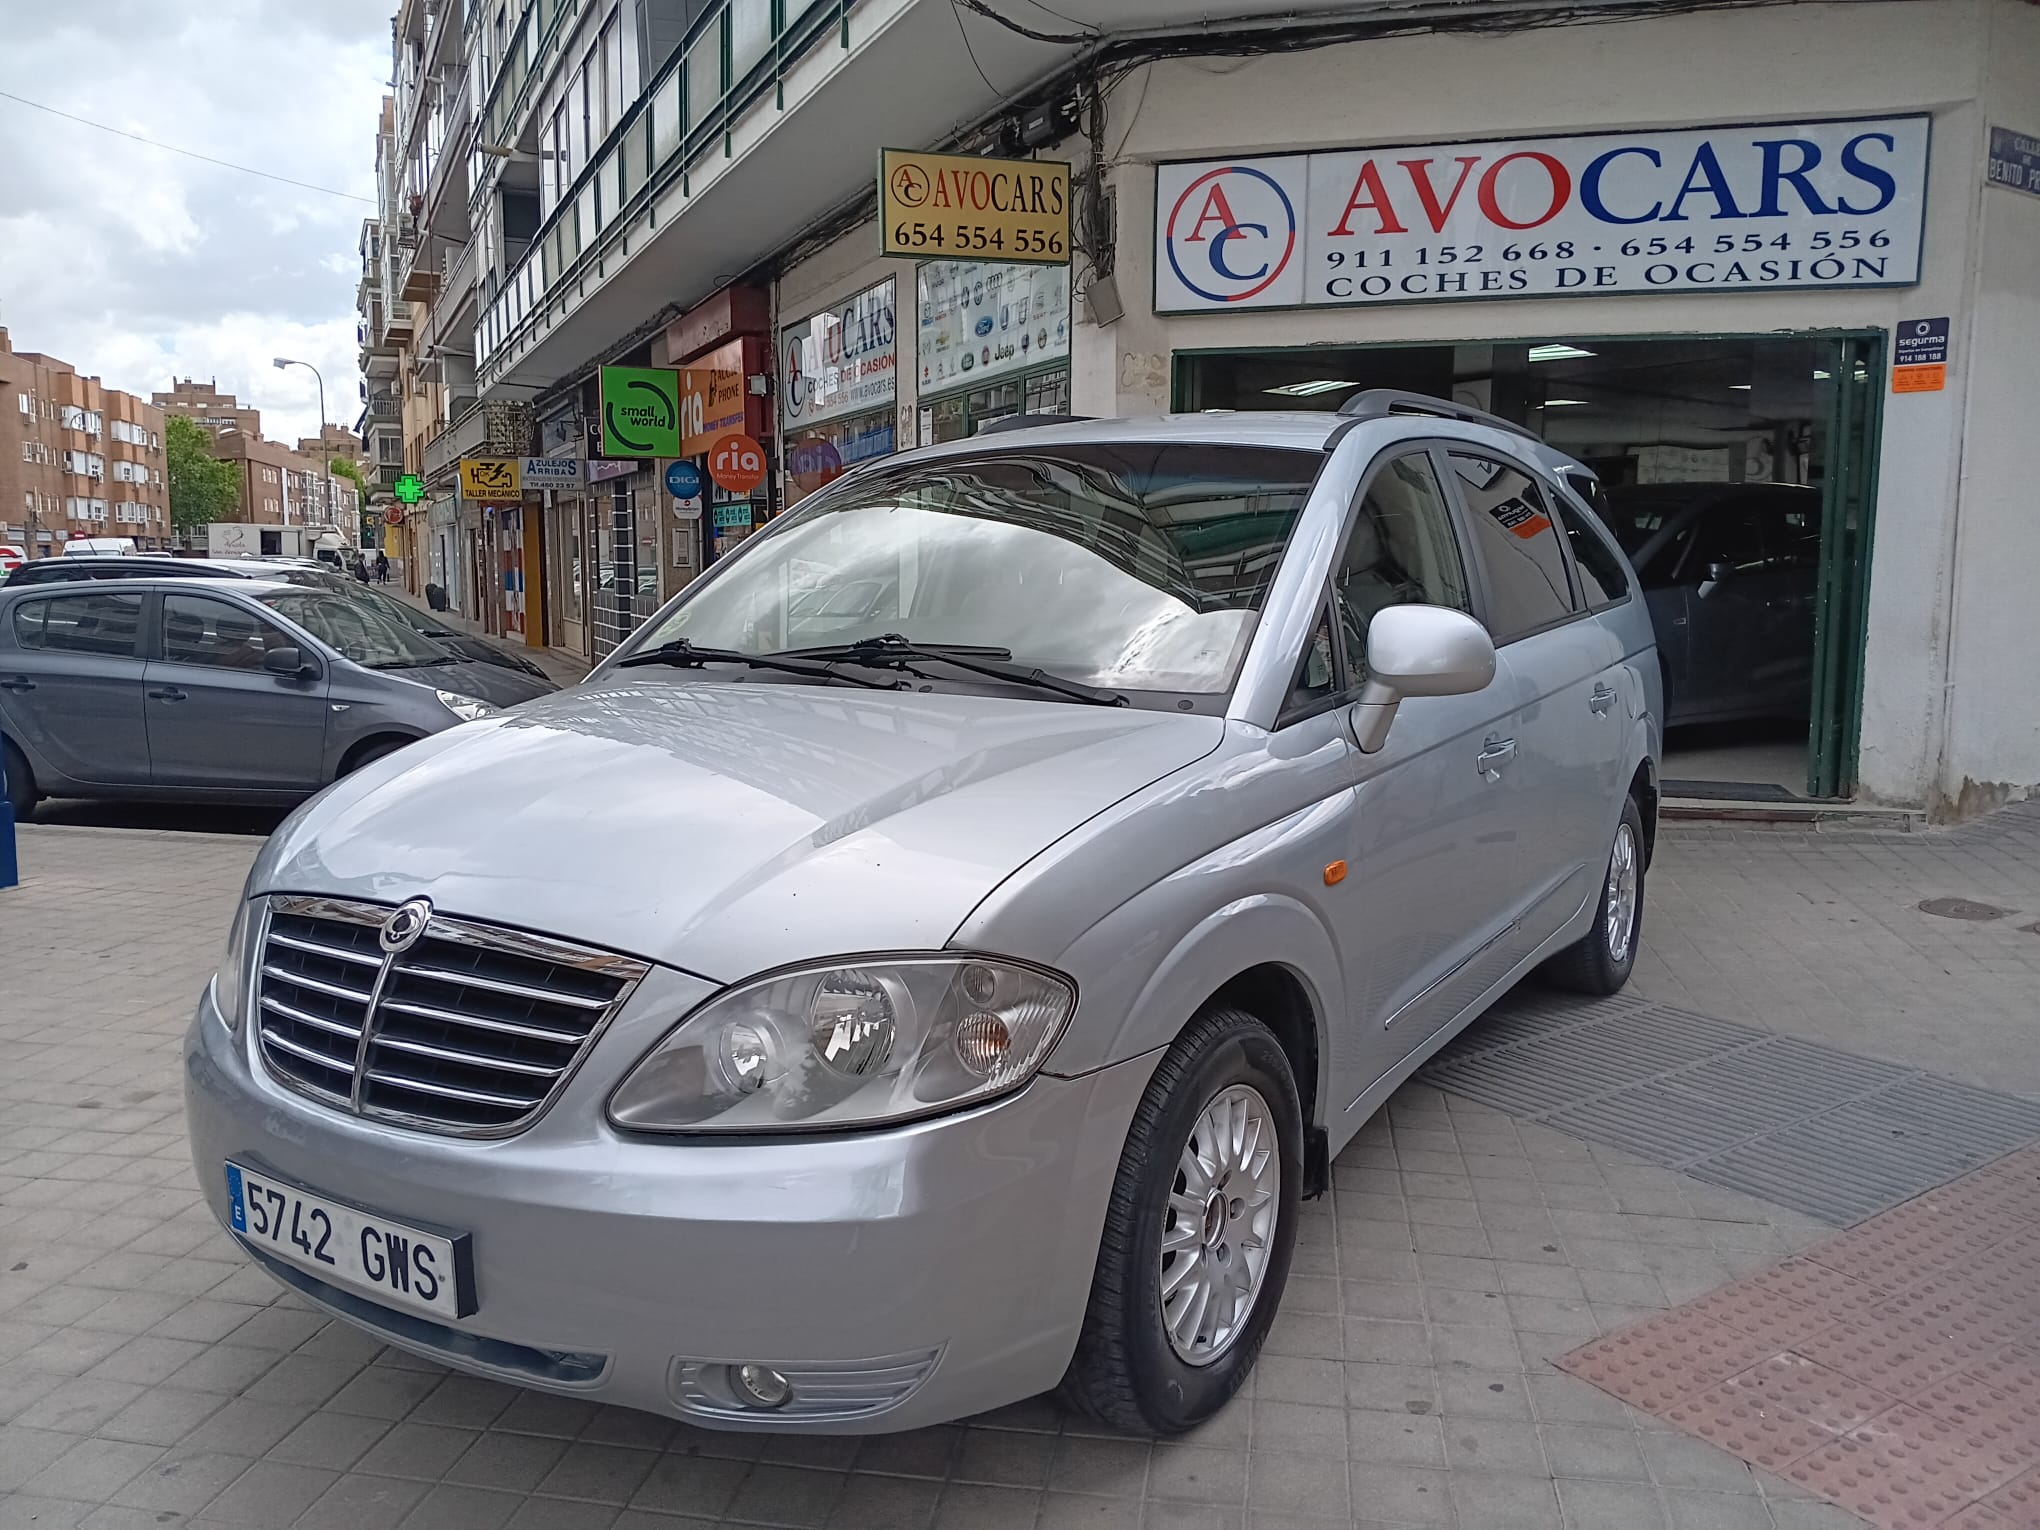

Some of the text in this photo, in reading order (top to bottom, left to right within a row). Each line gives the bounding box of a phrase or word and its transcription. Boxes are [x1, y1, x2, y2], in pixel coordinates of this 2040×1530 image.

[1990, 158, 2023, 185] BENITO
[932, 168, 1063, 215] AVOCARS
[1328, 132, 1896, 237] AVOCARS
[895, 221, 1063, 255] 654 554 556
[1327, 229, 1891, 270] 911 152 668 654 554 556
[1326, 252, 1889, 297] COCHES DE OCASIÓN
[1898, 335, 1945, 347] segurma
[994, 343, 1015, 361] Jeep
[1900, 354, 1912, 362] 914
[841, 366, 852, 382] DE
[854, 352, 895, 379] OCASIÓN
[718, 383, 740, 404] PHONE
[621, 405, 655, 417] small
[681, 371, 704, 441] ria
[631, 414, 666, 427] world
[527, 460, 577, 471] AZULEJOS
[716, 441, 760, 471] ria
[527, 463, 577, 475] ARRIBAS
[716, 472, 736, 480] Money
[669, 476, 700, 484] DIGI
[465, 488, 520, 498] TALLER MECÁNICO
[235, 1181, 438, 1301] E 5742 GWS
